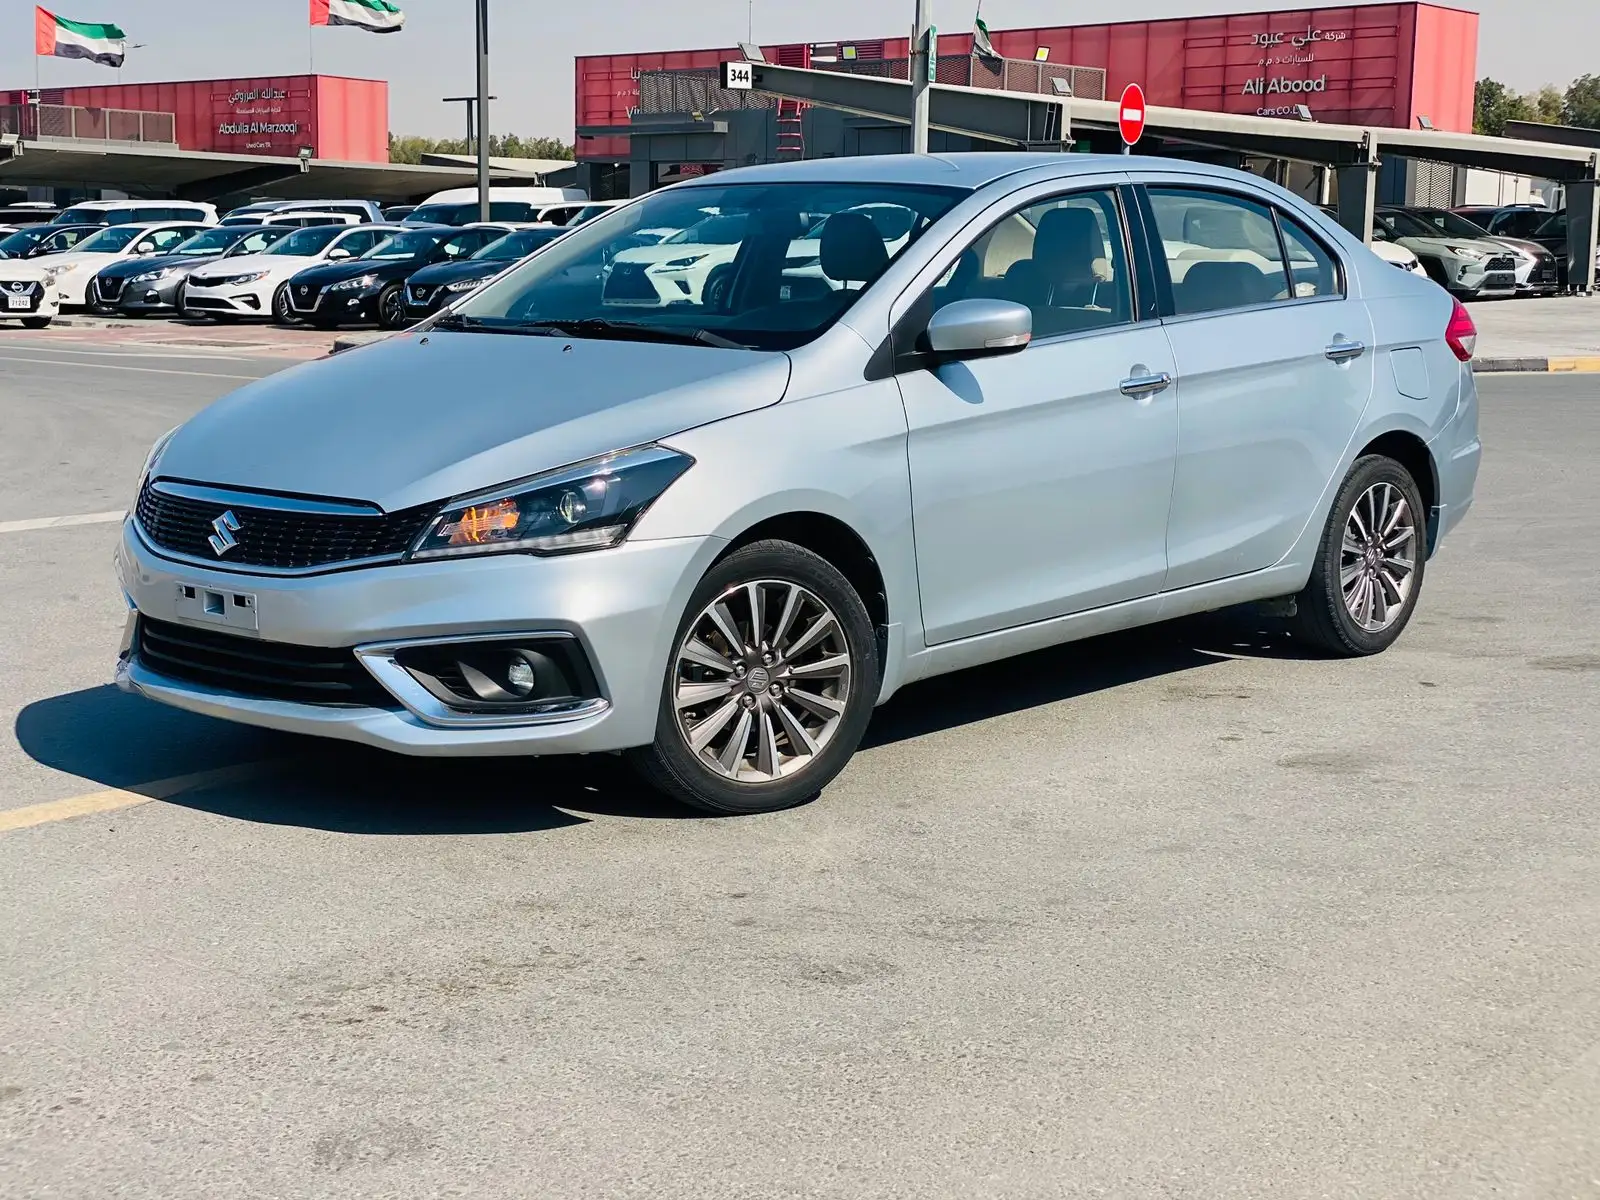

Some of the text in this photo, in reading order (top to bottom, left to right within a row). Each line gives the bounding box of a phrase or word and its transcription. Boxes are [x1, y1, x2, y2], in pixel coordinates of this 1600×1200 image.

[1250, 25, 1346, 50] شركة علي عبود
[1282, 53, 1314, 66] للسيارات
[730, 69, 749, 82] 344
[1242, 74, 1326, 95] Ali Abood
[1256, 107, 1276, 116] Cars
[219, 120, 298, 135] Abdulla Al Marzooqi
